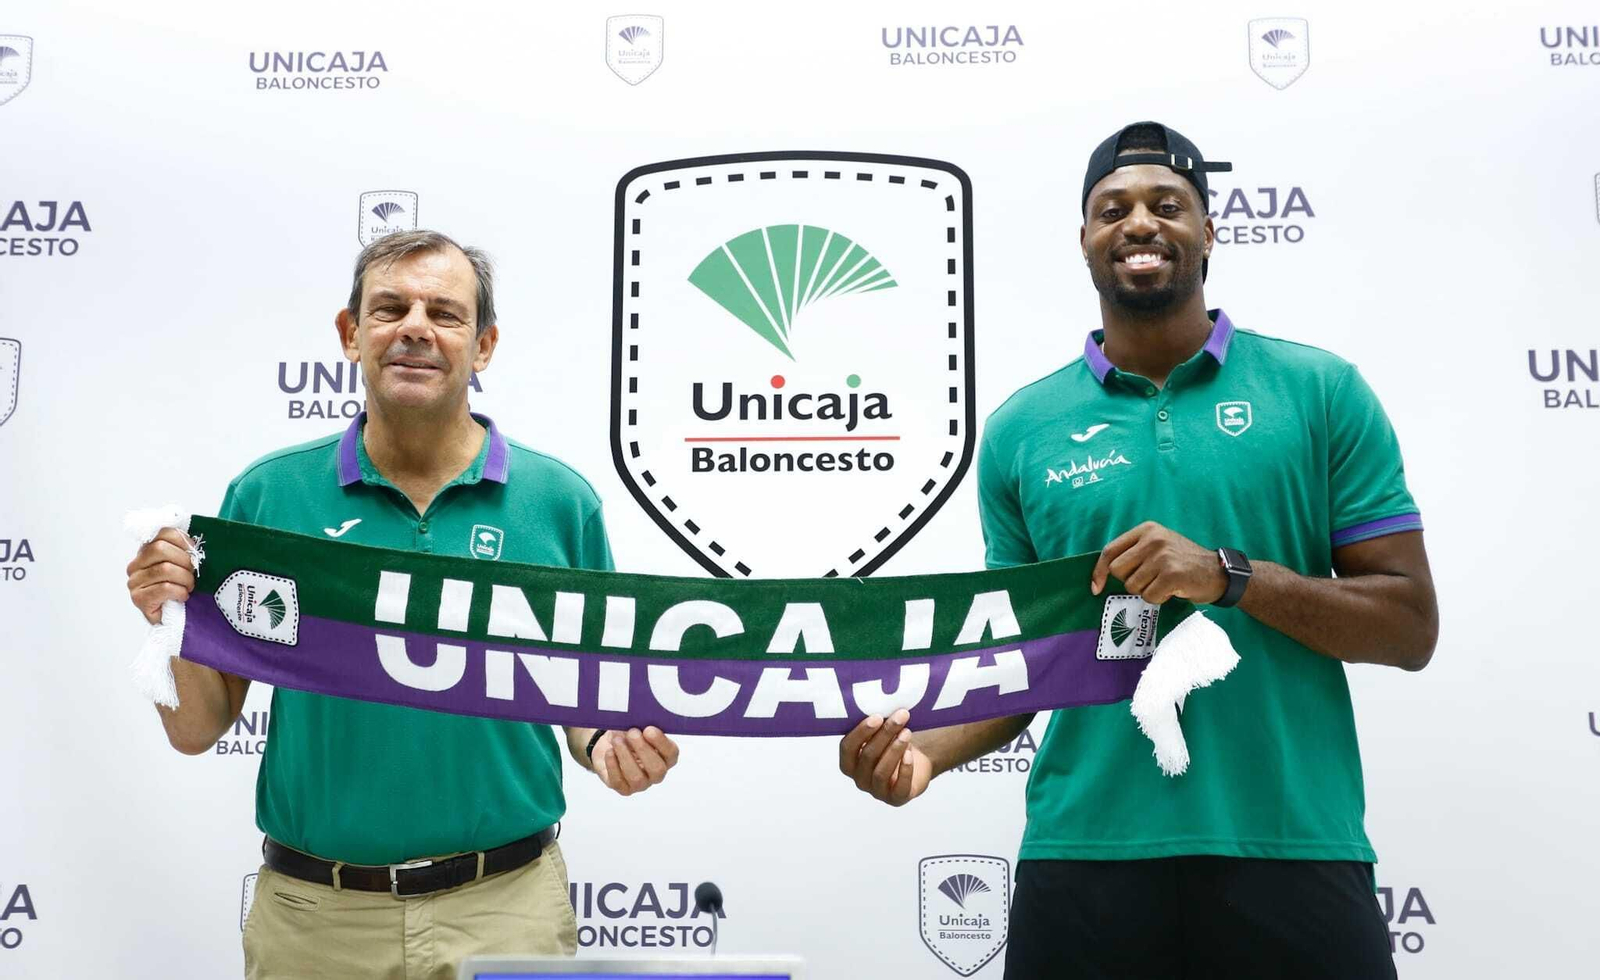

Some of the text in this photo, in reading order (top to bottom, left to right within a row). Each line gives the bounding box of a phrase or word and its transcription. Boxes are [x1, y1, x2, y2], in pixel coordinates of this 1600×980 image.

[882, 25, 1025, 48] UNICAJA
[249, 51, 388, 73] UNICAJA
[890, 50, 1017, 66] BALONCESTO
[256, 76, 381, 90] BALONCESTO
[692, 374, 893, 432] Unicaja
[692, 446, 895, 473] Baloncesto
[1045, 449, 1131, 487] Andalucía
[246, 584, 257, 624] Unicaja
[1136, 608, 1151, 648] Unicaja
[375, 569, 1030, 720] UNICAJA
[939, 913, 990, 929] Unicaja
[939, 931, 992, 940] Baloncesto
